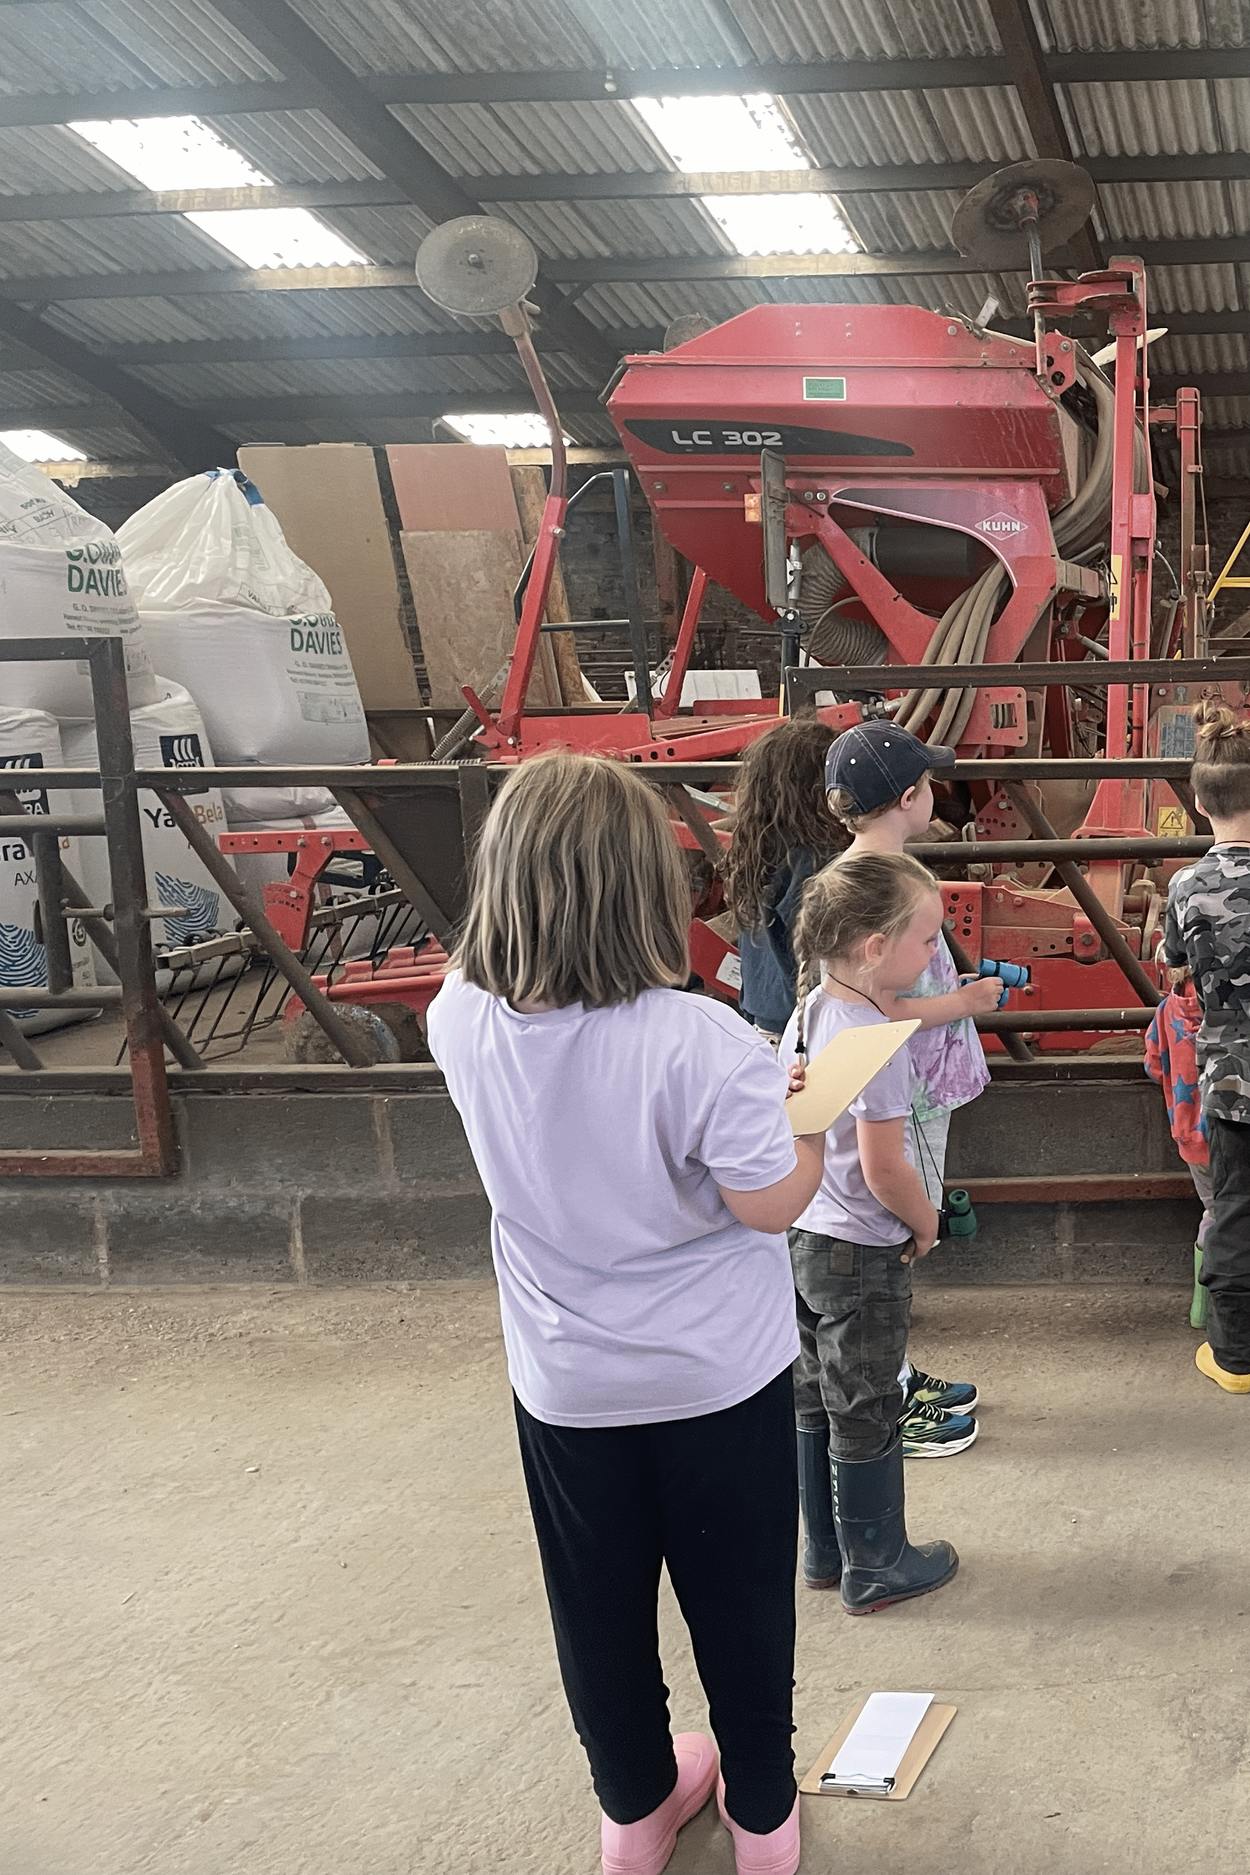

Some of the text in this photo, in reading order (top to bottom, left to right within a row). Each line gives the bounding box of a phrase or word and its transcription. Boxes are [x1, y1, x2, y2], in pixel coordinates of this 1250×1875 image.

[671, 430, 783, 446] LC 302
[982, 521, 1021, 532] KUHN
[290, 627, 343, 656] DAVIES
